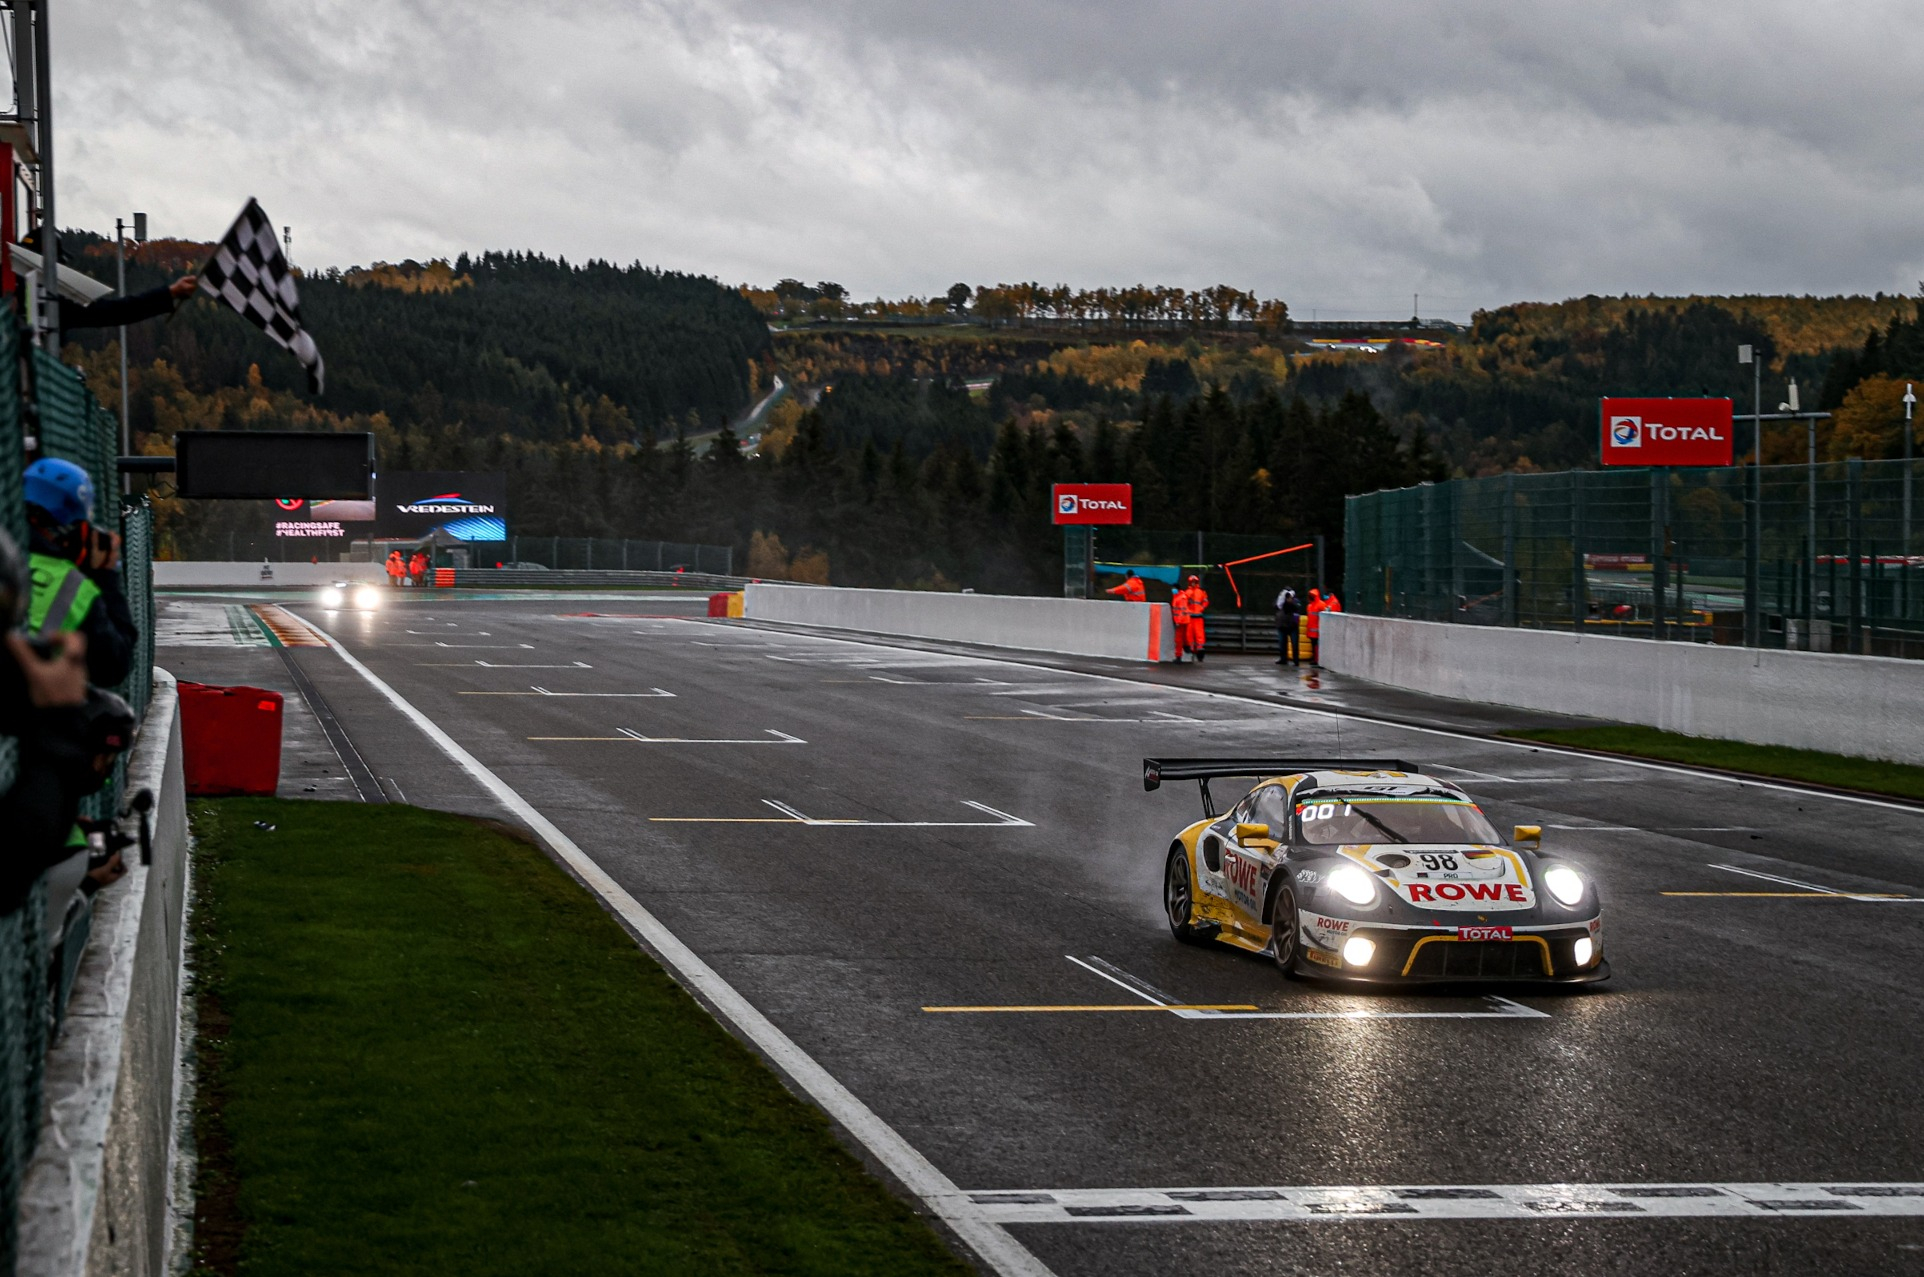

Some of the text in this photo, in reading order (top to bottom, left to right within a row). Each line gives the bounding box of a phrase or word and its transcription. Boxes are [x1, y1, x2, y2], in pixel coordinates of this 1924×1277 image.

[1645, 423, 1724, 440] TOTAL
[397, 505, 494, 513] VREDESTEIN
[1079, 498, 1127, 509] TOTAL
[1420, 854, 1459, 871] 98
[1408, 883, 1527, 902] ROWE
[1317, 917, 1349, 931] ROWE
[1460, 928, 1511, 939] TOTAL
